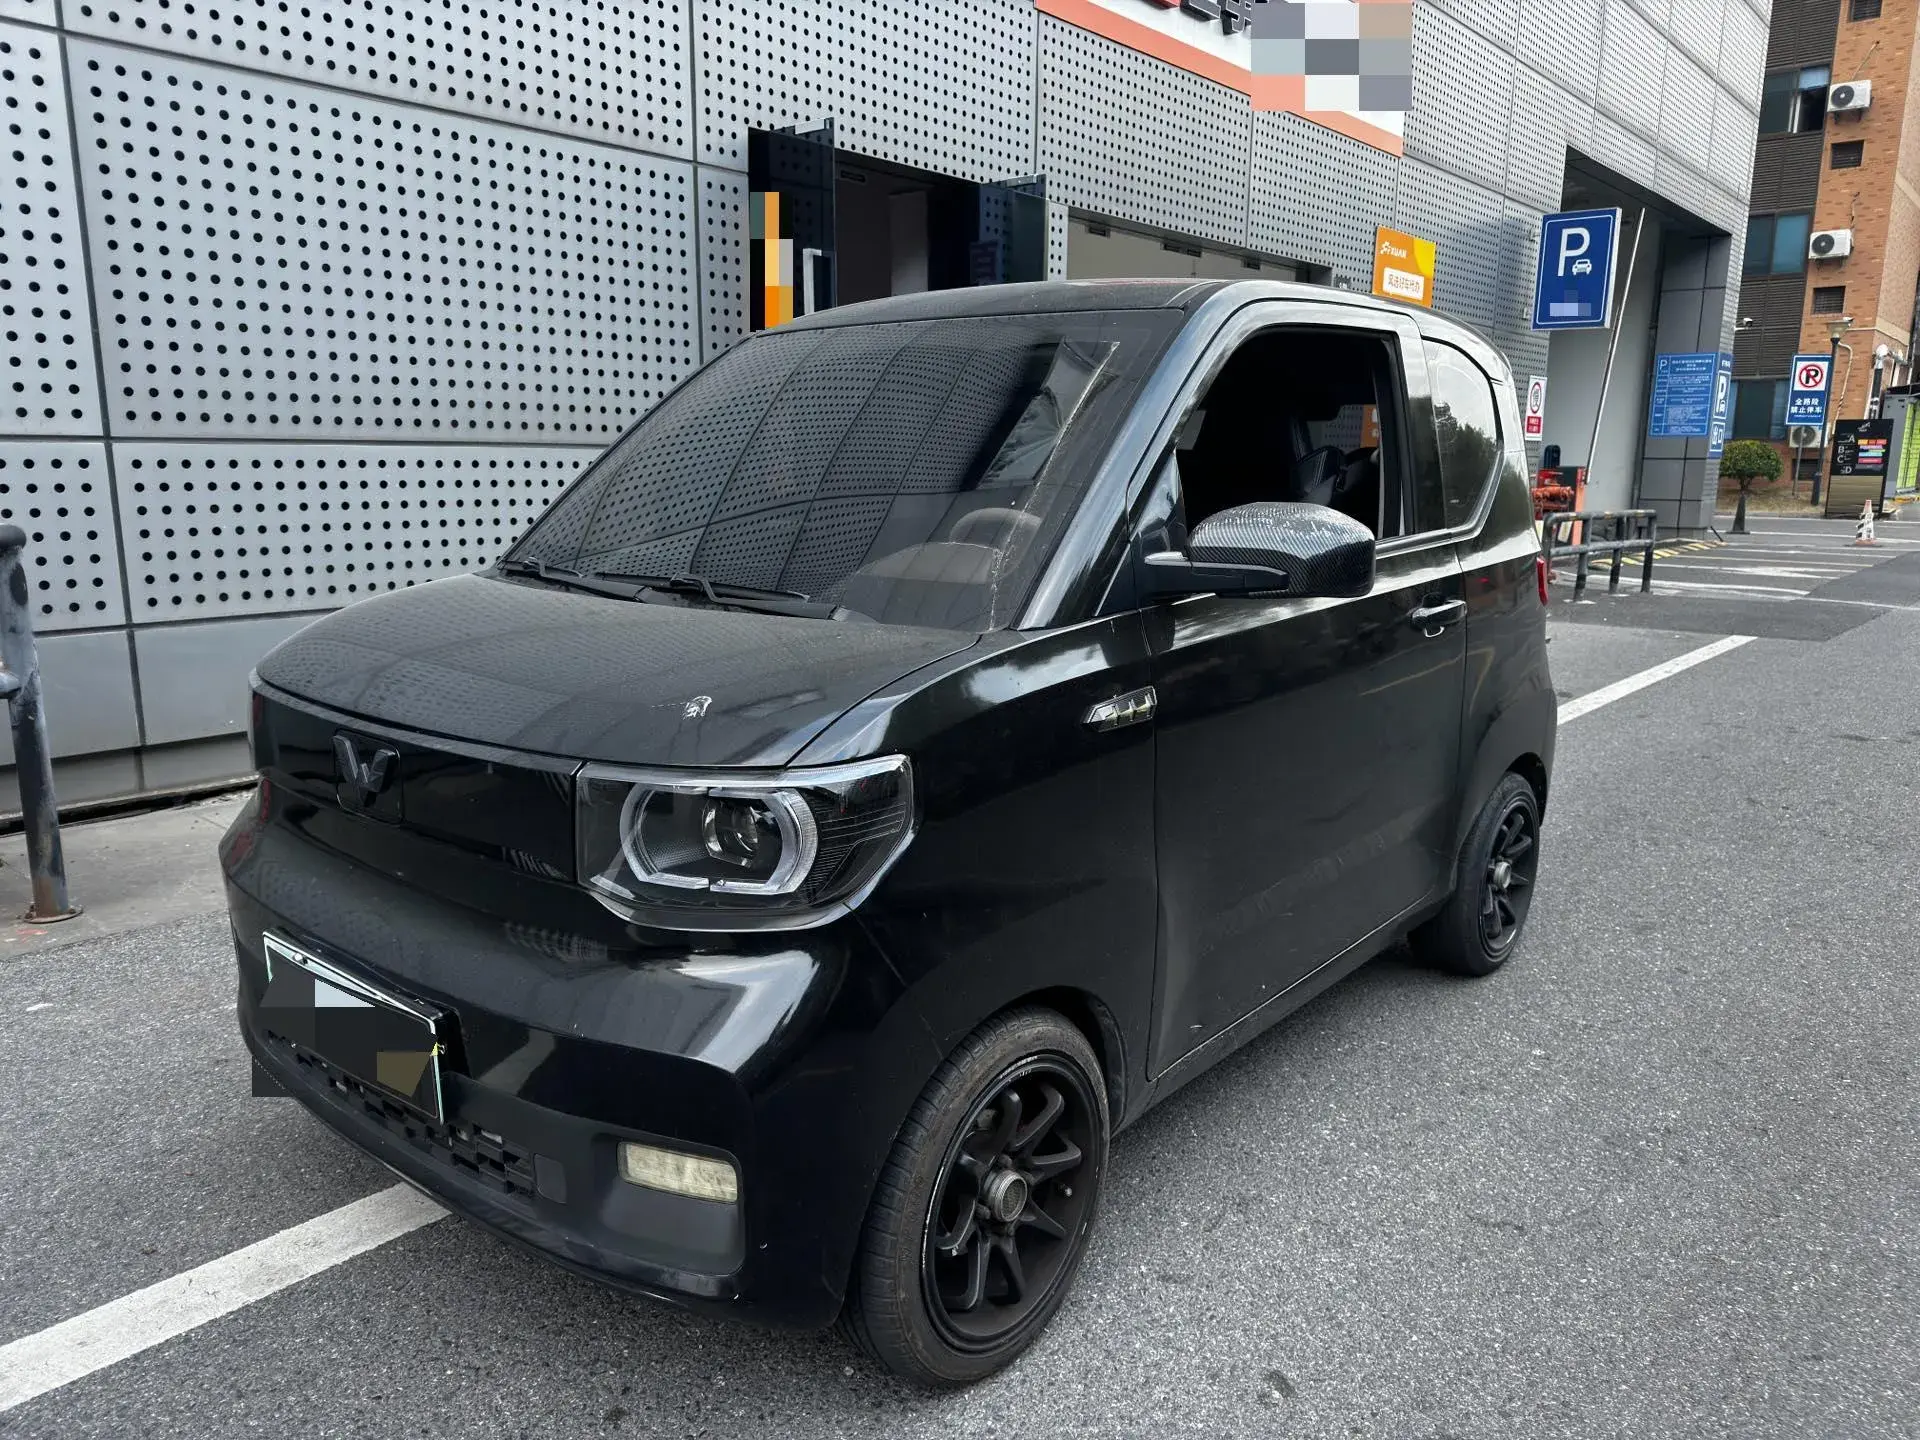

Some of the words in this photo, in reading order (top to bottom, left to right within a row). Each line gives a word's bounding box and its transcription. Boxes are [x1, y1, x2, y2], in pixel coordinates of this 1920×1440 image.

[1557, 227, 1591, 277] P
[1716, 375, 1726, 413] P
[1838, 446, 1845, 454] B
[1837, 455, 1844, 463] C
[1845, 466, 1852, 474] D
